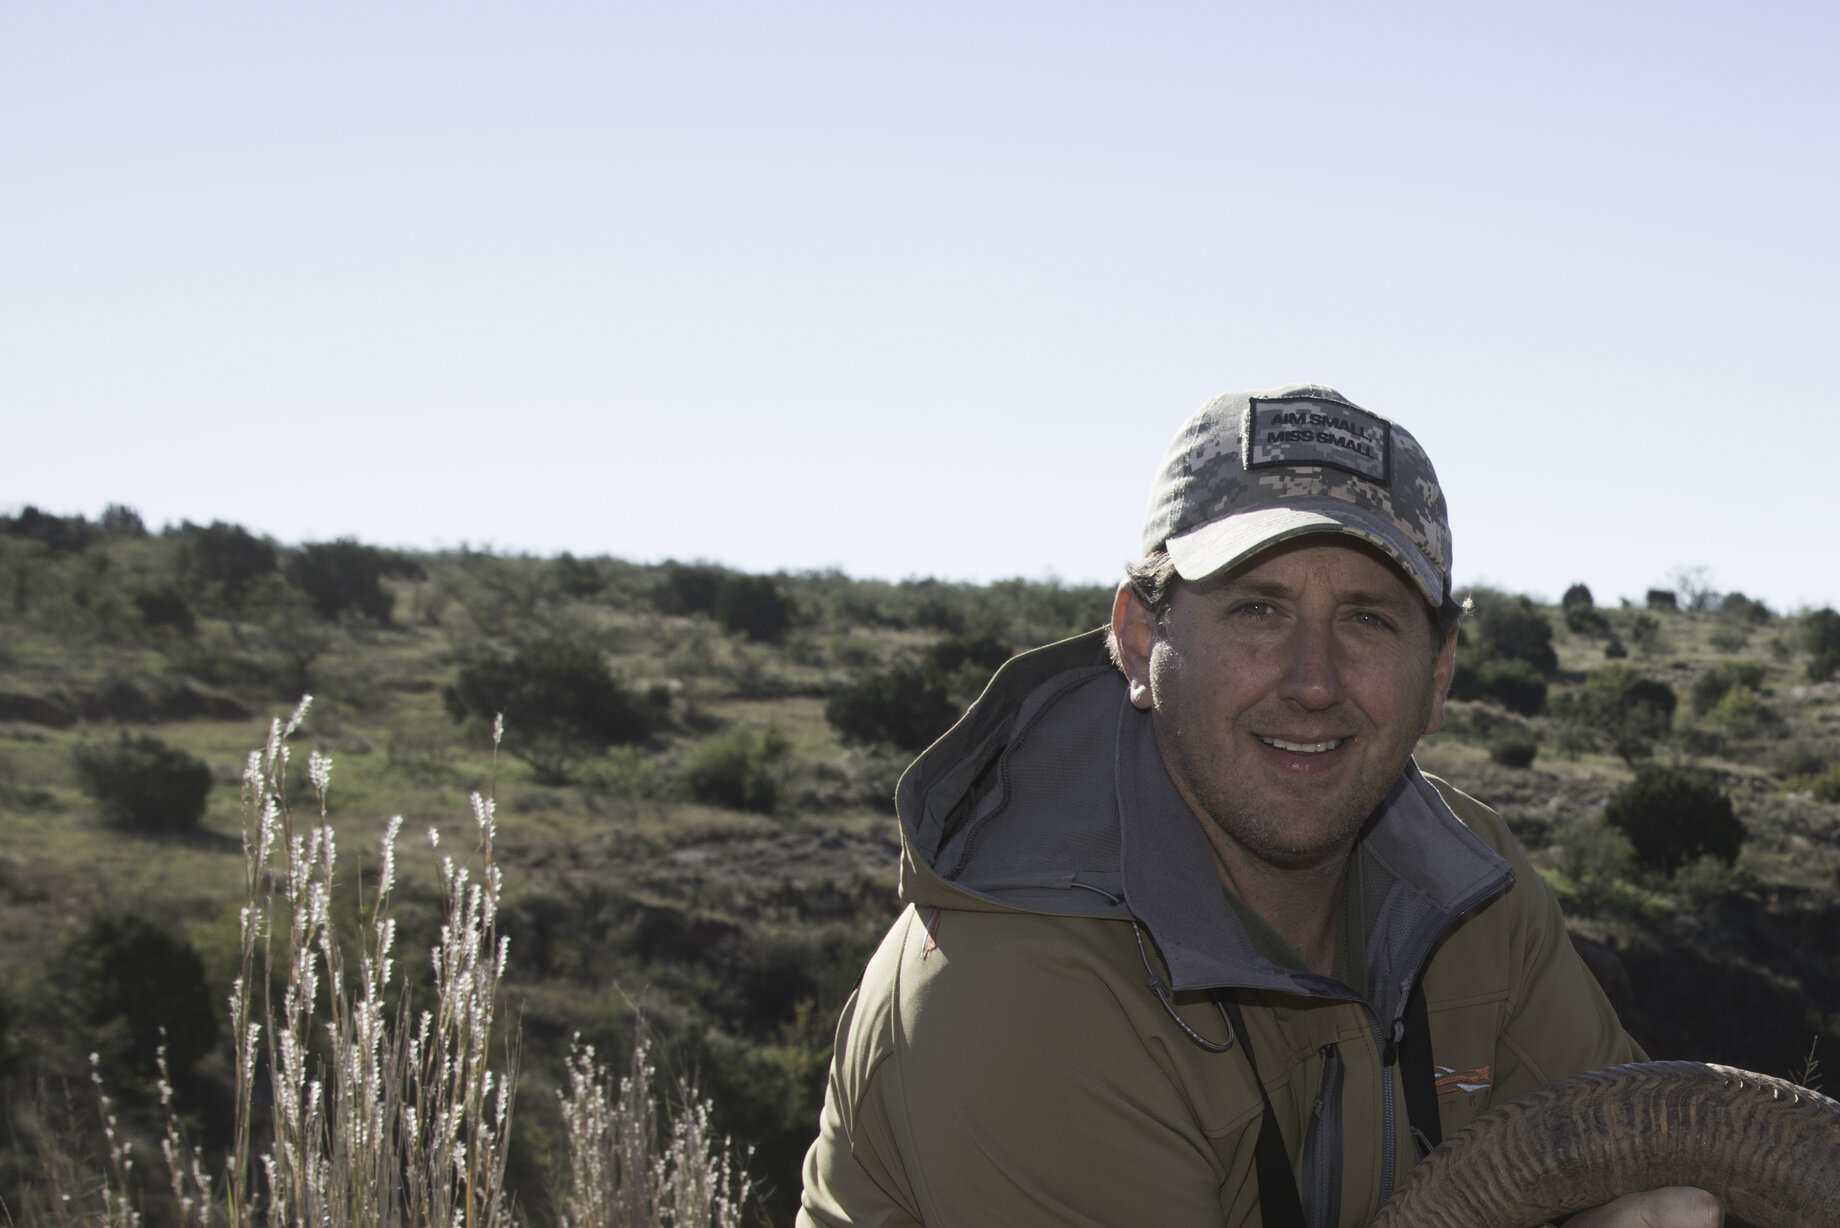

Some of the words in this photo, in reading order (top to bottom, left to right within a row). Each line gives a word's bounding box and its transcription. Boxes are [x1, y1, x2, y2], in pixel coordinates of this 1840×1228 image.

[1271, 412, 1307, 425] AIM
[1267, 430, 1314, 443] MISS
[1316, 432, 1375, 459] SMALL
